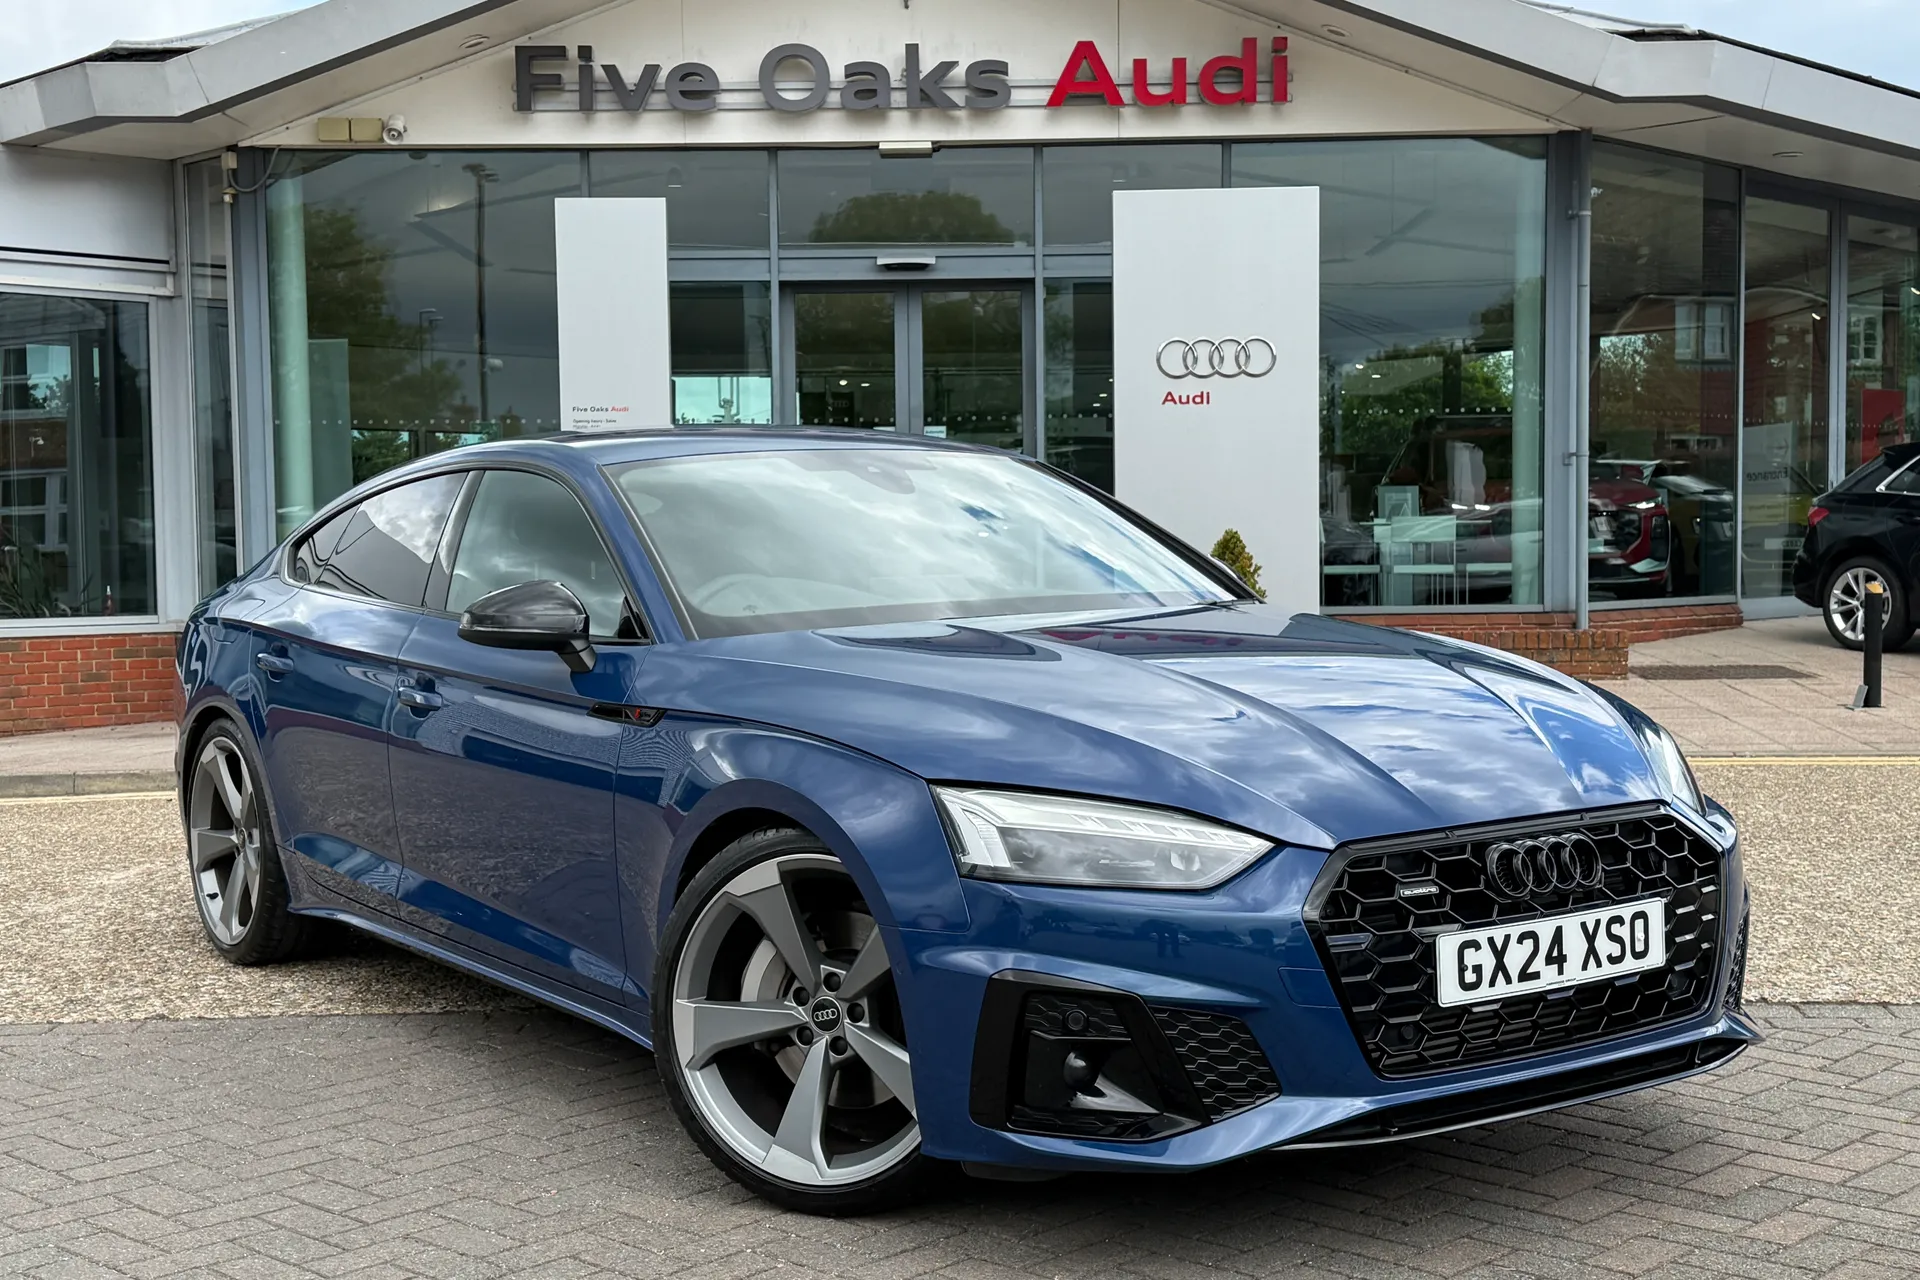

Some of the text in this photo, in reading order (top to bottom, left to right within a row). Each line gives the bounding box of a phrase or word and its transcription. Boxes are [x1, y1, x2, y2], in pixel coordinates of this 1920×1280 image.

[514, 36, 1290, 112] Five Oaks Audi
[1161, 391, 1211, 405] Audi
[1403, 887, 1437, 895] quattro
[1457, 910, 1649, 992] GX24 XSO
